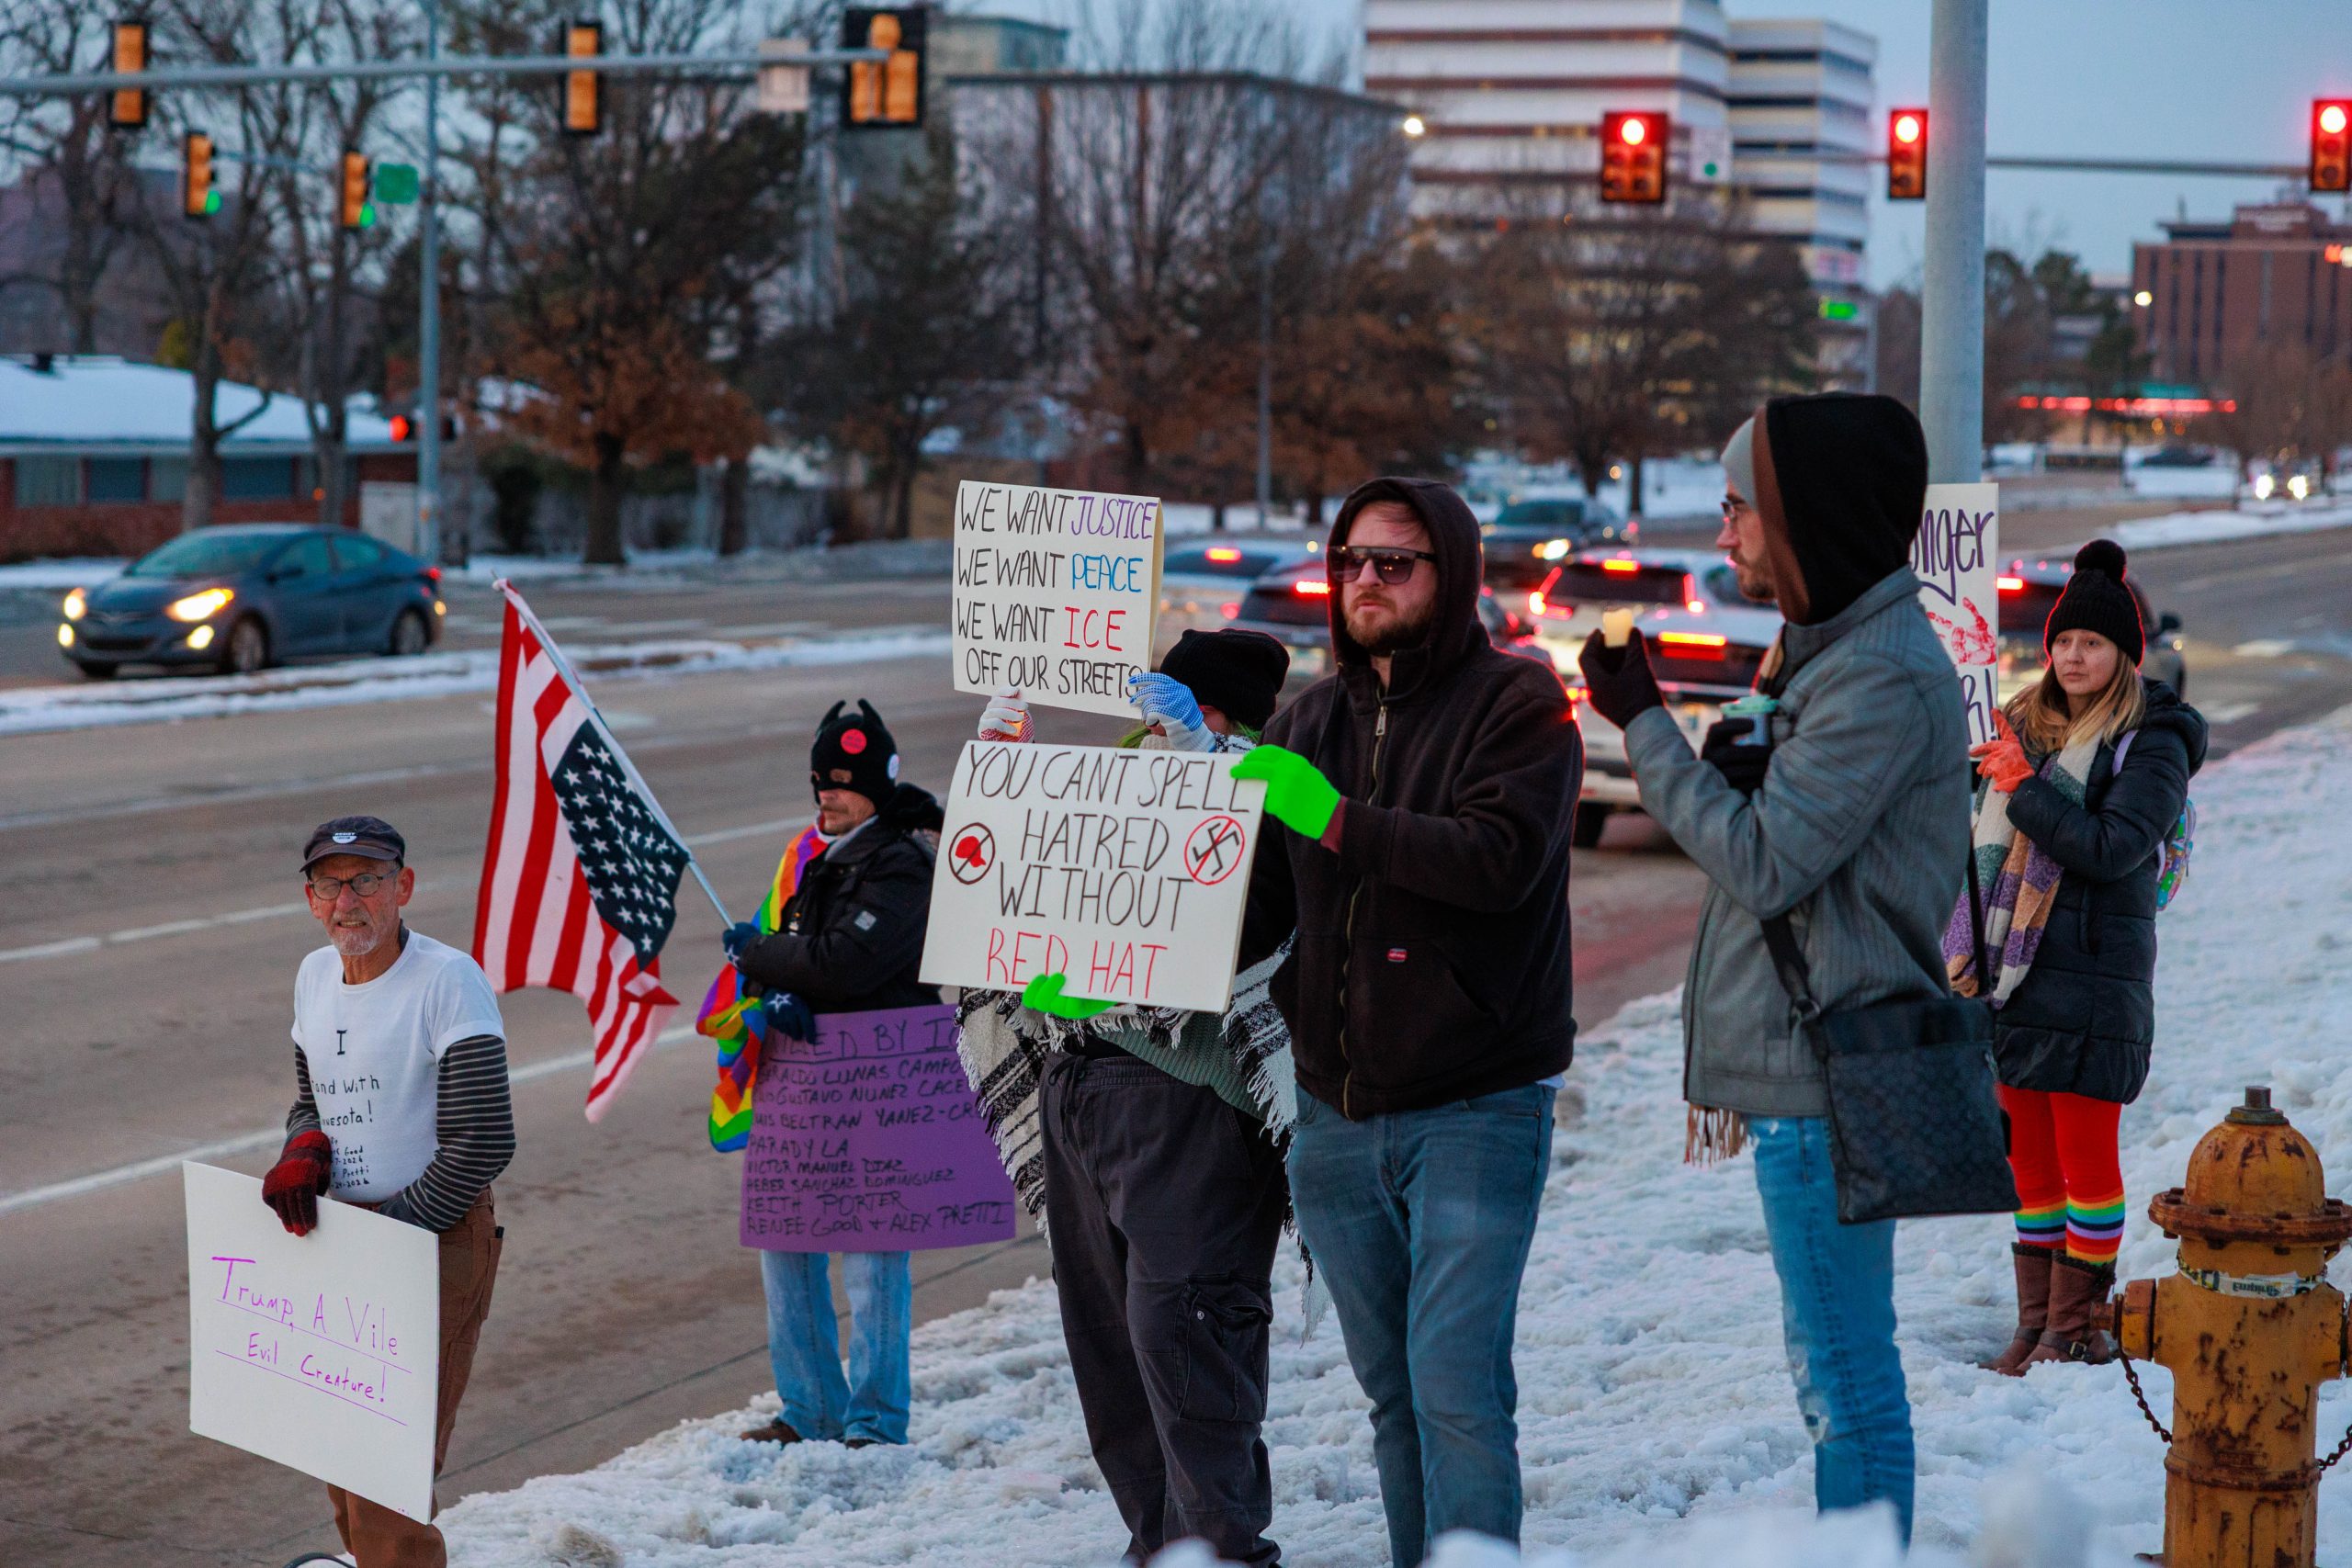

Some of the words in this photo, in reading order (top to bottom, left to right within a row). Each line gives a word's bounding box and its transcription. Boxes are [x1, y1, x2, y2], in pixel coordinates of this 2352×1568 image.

[960, 487, 1002, 532] WE
[1007, 490, 1075, 535] WANT
[1070, 495, 1158, 539] JUSTICE
[958, 547, 992, 587] WE
[996, 548, 1065, 588] WANT
[1071, 553, 1144, 592] PEACE
[1912, 508, 1995, 606] nger
[956, 597, 986, 640] WE
[992, 603, 1055, 643] WANT
[1063, 606, 1126, 651] ICE
[966, 648, 1002, 685] OFF
[1008, 655, 1050, 690] OUR
[1959, 668, 1996, 744] R!
[966, 743, 1038, 799] YOU
[1137, 756, 1250, 813] SPELL
[1020, 808, 1170, 872] HATRED
[1001, 861, 1194, 931] WITHOUT
[987, 928, 1069, 985] RED
[1088, 940, 1169, 999] HAT
[336, 1029, 347, 1055] I
[874, 1020, 907, 1052] BY
[823, 1065, 890, 1084] LUNAS
[898, 1057, 960, 1079] CAMPO
[780, 1110, 862, 1131] BELTRAN
[876, 1102, 979, 1127] YANEZ-CR
[821, 1139, 848, 1158] LA
[816, 1190, 910, 1217] PORTER
[889, 1213, 932, 1233] ALEX
[937, 1201, 1013, 1230] PRETTI
[312, 1293, 327, 1333] A
[345, 1297, 398, 1356] Vile
[248, 1333, 278, 1365] Evil
